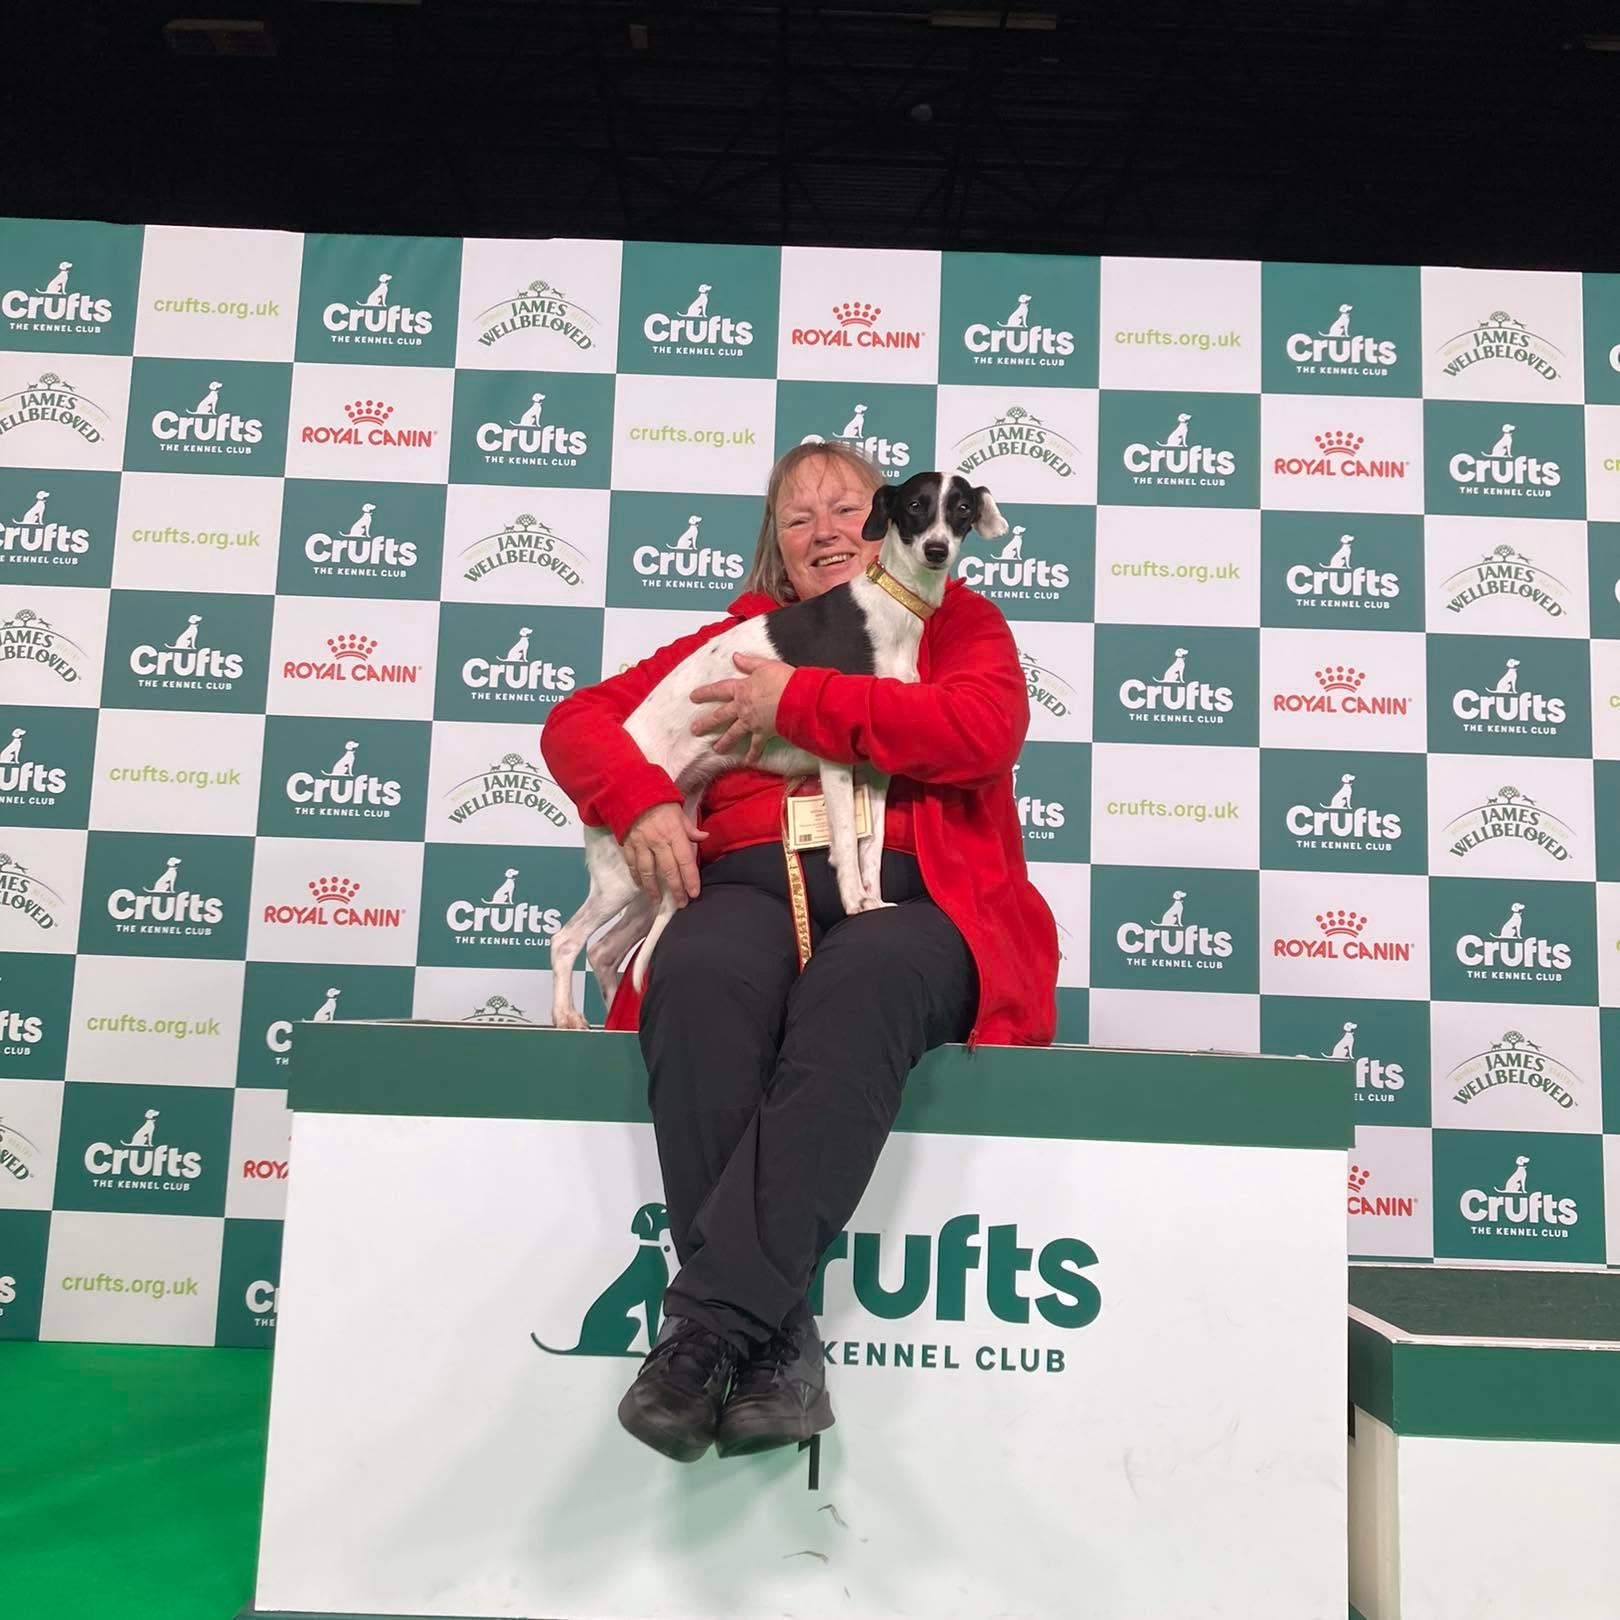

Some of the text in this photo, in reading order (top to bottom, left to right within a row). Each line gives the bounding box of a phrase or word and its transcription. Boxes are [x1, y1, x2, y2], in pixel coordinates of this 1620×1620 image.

[1, 290, 112, 323] Crufts
[153, 296, 279, 319] crufts.org.uk
[511, 300, 568, 317] JAMES
[10, 322, 101, 333] THE KENNEL CLUB
[323, 303, 432, 334] Crufts
[478, 314, 592, 350] WELLBELOVED
[644, 313, 753, 346] Crufts
[792, 329, 920, 348] ROYAL CANIN
[1115, 328, 1241, 351] crufts.org.uk
[1473, 331, 1530, 347] JAMES
[331, 335, 422, 346] THE KENNEL CLUB
[964, 324, 1074, 356] Crufts
[1286, 333, 1397, 365] Crufts
[652, 346, 743, 356] THE KENNEL CLUB
[974, 356, 1064, 366] THE KENNEL CLUB
[1296, 366, 1388, 376] THE KENNEL CLUB
[1443, 345, 1556, 380] WELLBELOVED
[21, 393, 78, 410] JAMES
[152, 410, 262, 443] Crufts
[629, 424, 755, 449] crufts.org.uk
[990, 427, 1046, 444] JAMES
[302, 427, 432, 447] ROYAL CANIN
[476, 422, 587, 455] Crufts
[183, 444, 223, 453] KENNEL
[226, 446, 252, 454] CLUB
[1123, 443, 1235, 475] Crufts
[485, 456, 576, 466] THE KENNEL CLUB
[957, 442, 1072, 477] WELLBELOVED
[1275, 458, 1404, 478] ROYAL CANIN
[1449, 453, 1561, 486] Crufts
[1157, 477, 1196, 486] KENNEL
[1200, 478, 1226, 486] CLUB
[1459, 486, 1552, 497] THE KENNEL CLUB
[131, 526, 259, 550] crufts.org.uk
[498, 535, 555, 552] JAMES
[304, 533, 417, 566] Crufts
[9, 555, 49, 564] KENNEL
[52, 557, 78, 565] CLUB
[464, 549, 580, 586] WELLBELOVED
[632, 545, 744, 579] Crufts
[313, 567, 406, 578] THE KENNEL CLUB
[957, 556, 1070, 588] Crufts
[1111, 559, 1239, 583] crufts.org.uk
[1286, 564, 1400, 598] Crufts
[1477, 565, 1534, 582] JAMES
[642, 579, 734, 590] THE KENNEL CLUB
[990, 590, 1030, 599] KENNEL
[1034, 592, 1060, 600] CLUB
[1296, 599, 1390, 609] THE KENNEL CLUB
[1446, 580, 1562, 617] WELLBELOVED
[130, 645, 243, 679] Crufts
[284, 662, 416, 682] ROYAL CANIN
[462, 658, 576, 691] Crufts
[138, 680, 232, 690] THE KENNEL CLUB
[471, 692, 535, 702] THE KENNEL
[1119, 679, 1234, 712] Crufts
[1274, 695, 1406, 715] ROYAL CANIN
[1452, 689, 1566, 723] Crufts
[1129, 713, 1224, 724] THE KENNEL CLUB
[1463, 724, 1557, 735] THE KENNEL CLUB
[109, 764, 240, 789] crufts.org.uk
[483, 774, 542, 792] JAMES
[286, 772, 401, 806] Crufts
[28, 797, 55, 805] CLUB
[448, 790, 567, 827] WELLBELOVED
[1106, 798, 1239, 823] crufts.org.uk
[295, 807, 390, 818] THE KENNEL CLUB
[1286, 805, 1402, 839] Crufts
[1481, 807, 1540, 825] JAMES
[1029, 831, 1055, 839] CLUB
[1450, 823, 1568, 861] WELLBELOVED
[1296, 840, 1392, 851] THE KENNEL CLUB
[108, 888, 223, 924] Crufts
[264, 906, 399, 926] ROYAL CANIN
[446, 900, 561, 935] Crufts
[116, 924, 212, 935] THE KENNEL CLUB
[1116, 922, 1233, 957] Crufts
[455, 936, 475, 944] THE
[480, 937, 520, 945] KENNEL
[1274, 939, 1408, 960] ROYAL CANIN
[1456, 934, 1572, 970] Crufts
[1126, 958, 1223, 969] THE KENNEL CLUB
[1467, 970, 1562, 981] THE KENNEL CLUB
[87, 1013, 219, 1040] crufts.org.uk
[4, 1047, 30, 1055] CLUB
[1486, 1053, 1545, 1072] JAMES
[1368, 1093, 1394, 1101] CLUB
[1453, 1069, 1573, 1109] WELLBELOVED
[84, 1142, 201, 1178] Crufts
[93, 1180, 190, 1191] THE KENNEL CLUB
[1348, 1197, 1412, 1216] CANIN
[1460, 1189, 1578, 1225] Crufts
[1471, 1226, 1568, 1238] THE KENNEL CLUB
[61, 1272, 198, 1300] crufts.org.uk
[254, 1319, 275, 1327] THE
[821, 1341, 1065, 1372] KENNEL CLUB
